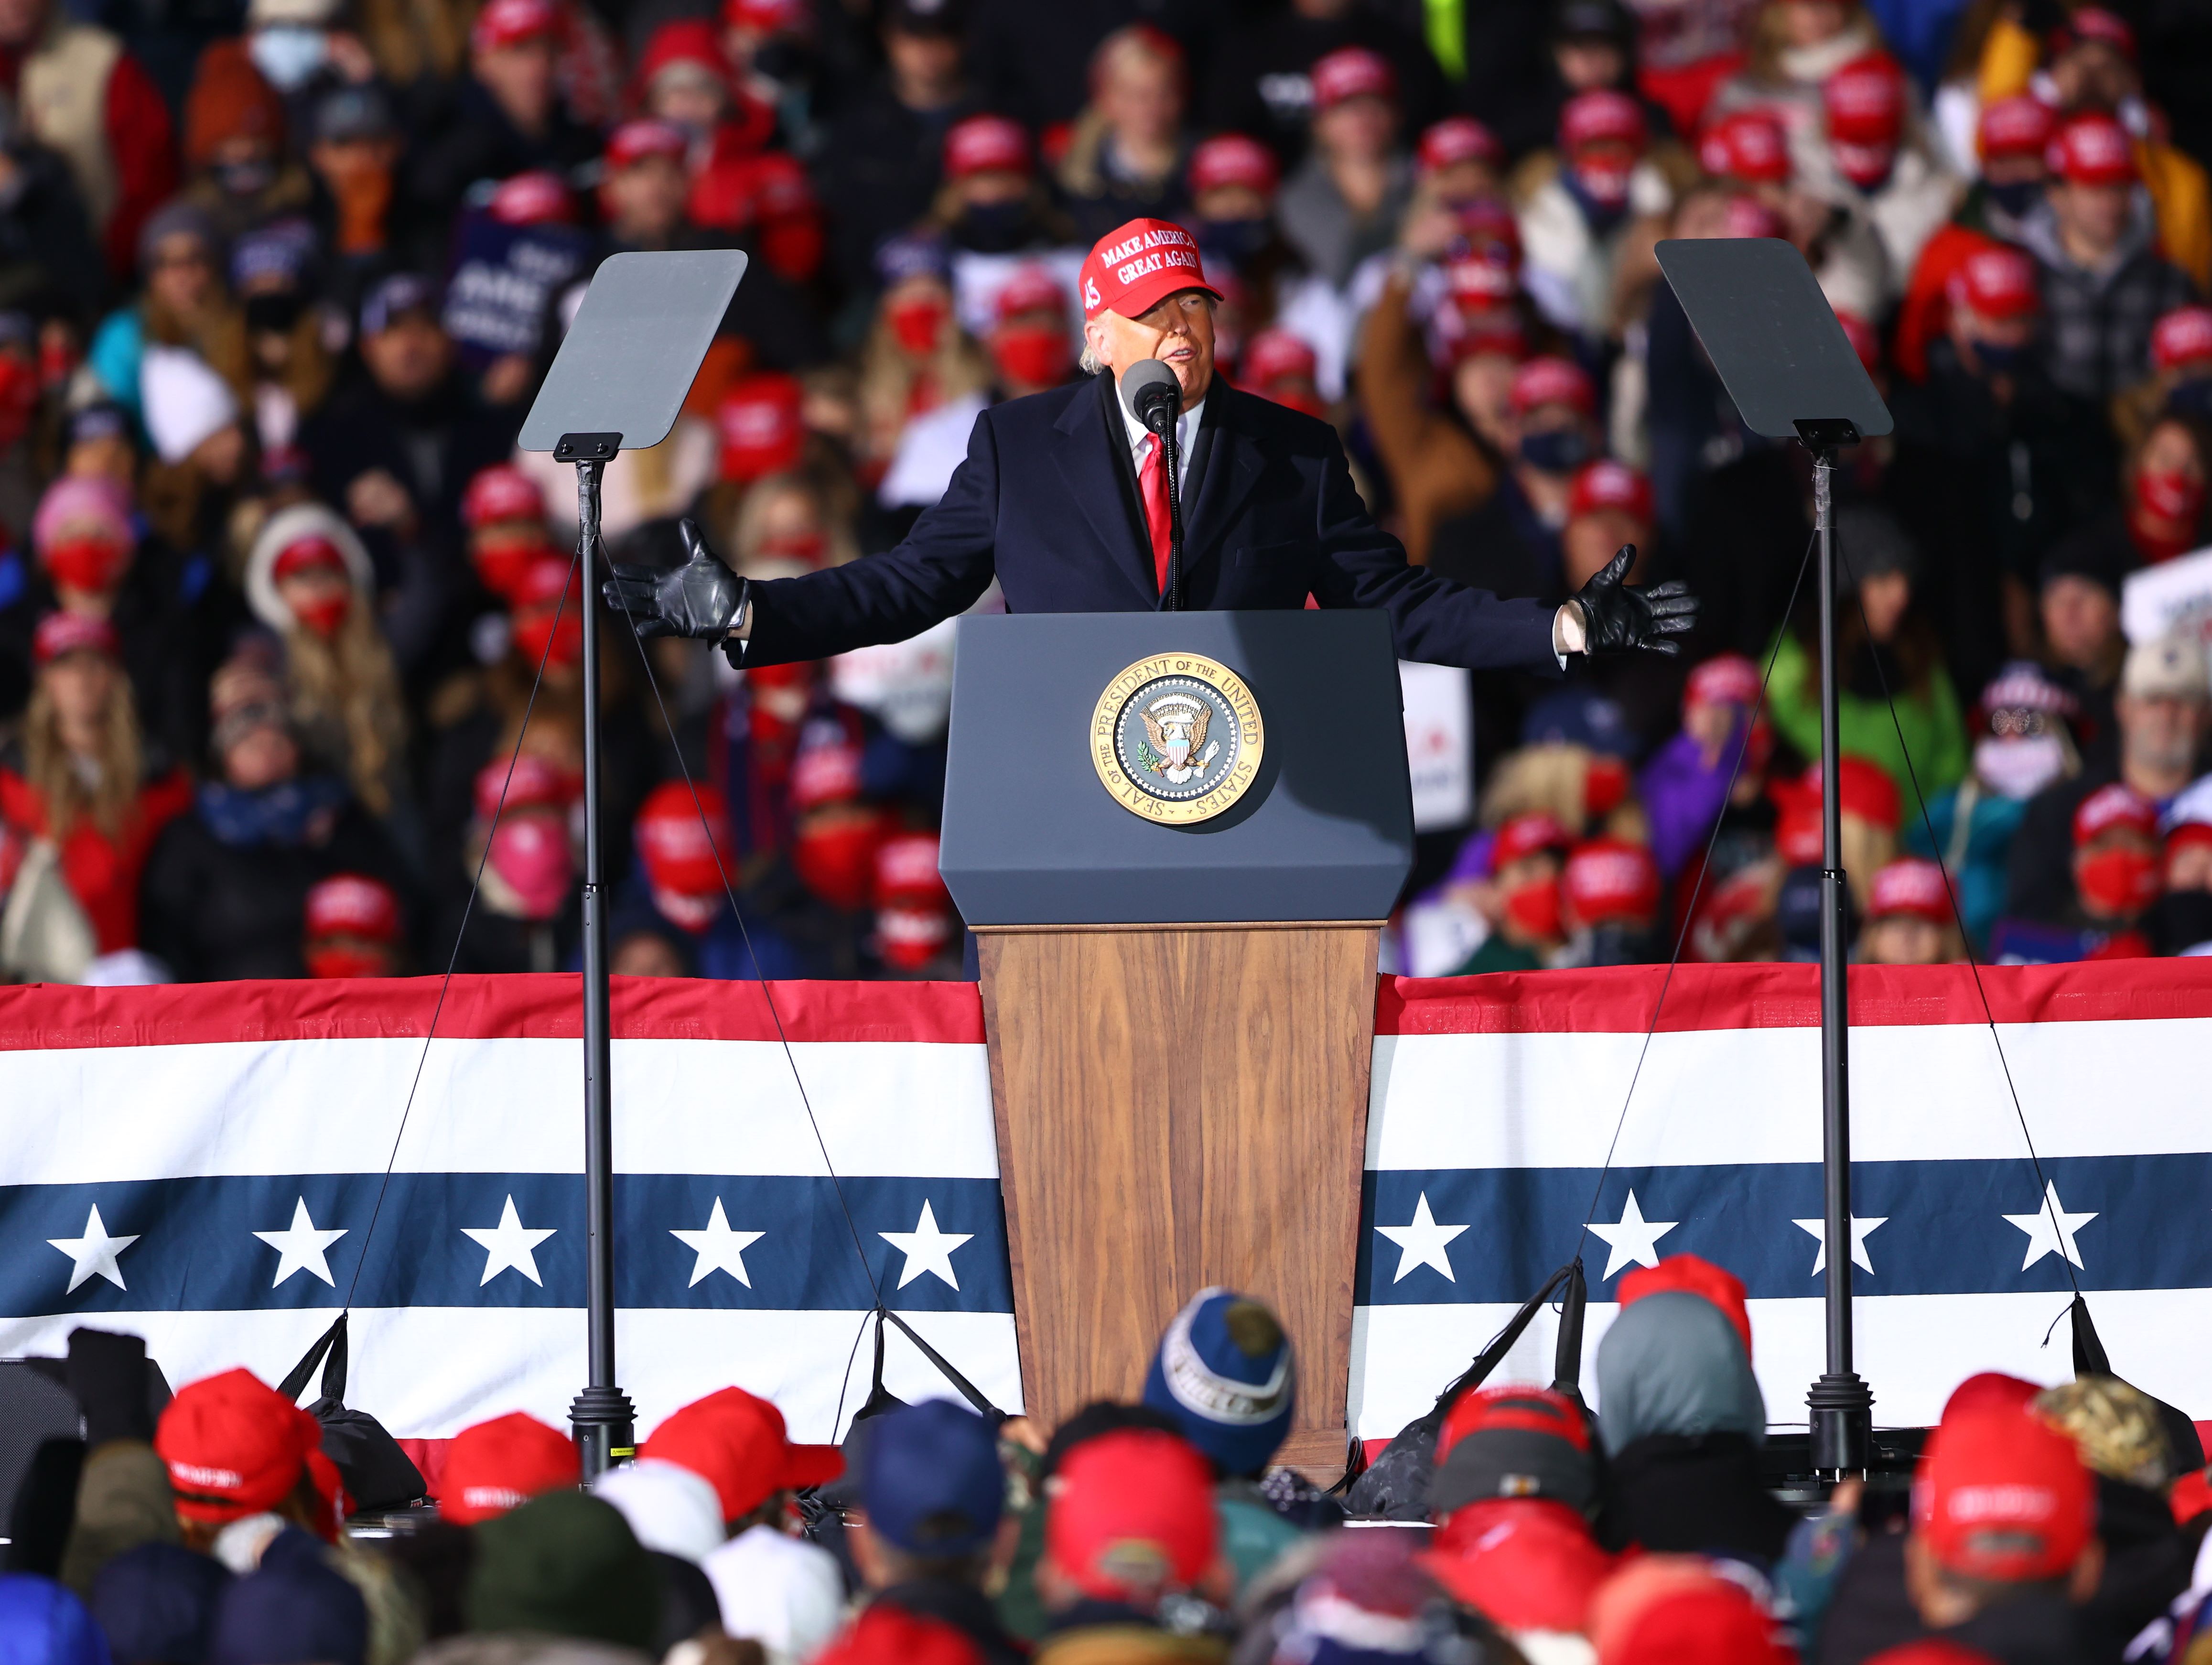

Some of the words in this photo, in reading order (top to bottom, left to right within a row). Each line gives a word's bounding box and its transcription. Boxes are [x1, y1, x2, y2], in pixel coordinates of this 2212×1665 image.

[1101, 236, 1144, 269] MAKE
[1145, 229, 1196, 249] AMERICA
[1118, 254, 1163, 285] GREAT
[1165, 250, 1197, 269] AGAIN
[1085, 276, 1101, 310] 45
[1175, 660, 1192, 671] OF
[1195, 663, 1217, 679] THE
[1097, 659, 1170, 736] PRESIDENT
[1221, 676, 1258, 746] UNITED
[1100, 744, 1113, 767] THE
[1107, 769, 1121, 784] OF
[1196, 761, 1252, 815] STATES
[1123, 782, 1165, 816] SEAL
